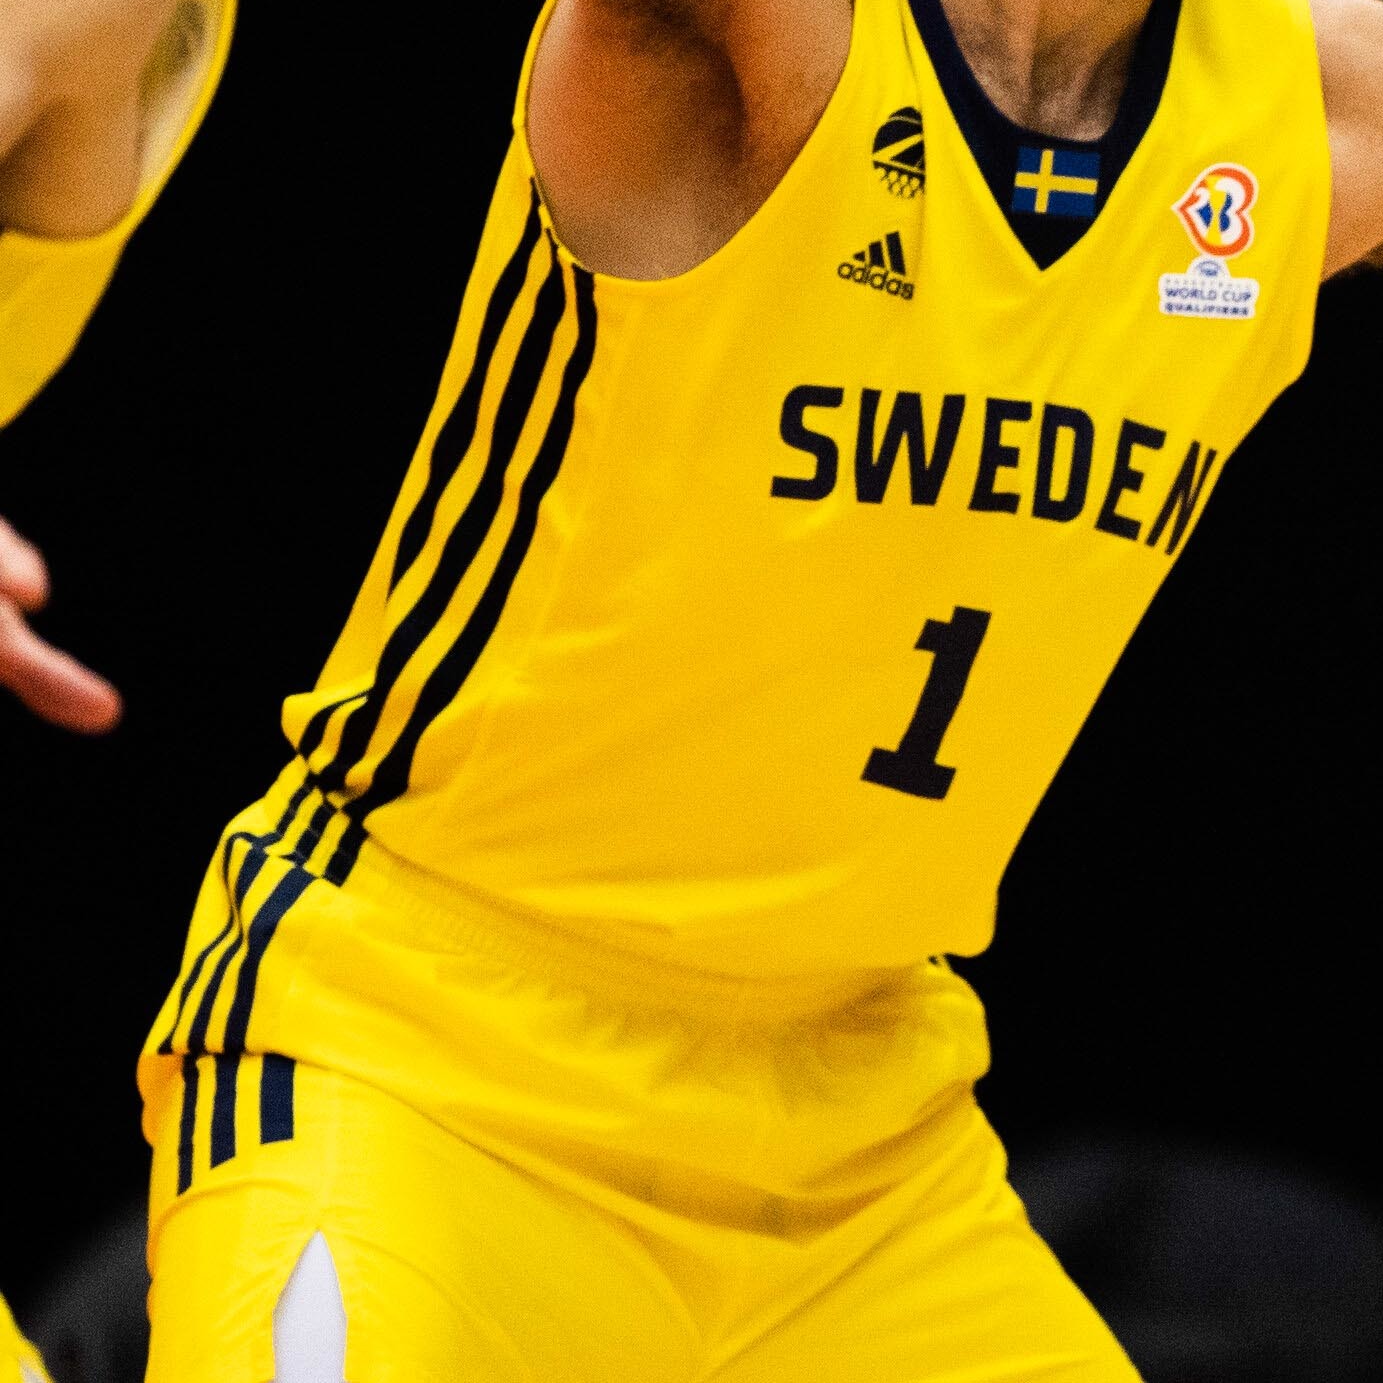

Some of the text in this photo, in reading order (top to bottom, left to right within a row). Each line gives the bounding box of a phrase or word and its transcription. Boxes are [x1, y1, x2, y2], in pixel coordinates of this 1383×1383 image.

[837, 262, 914, 300] adidas
[1165, 288, 1251, 302] WORLD CUP
[1165, 303, 1249, 315] QUALIFIERS
[770, 384, 1217, 555] SWEDEN
[860, 606, 991, 801] 1
